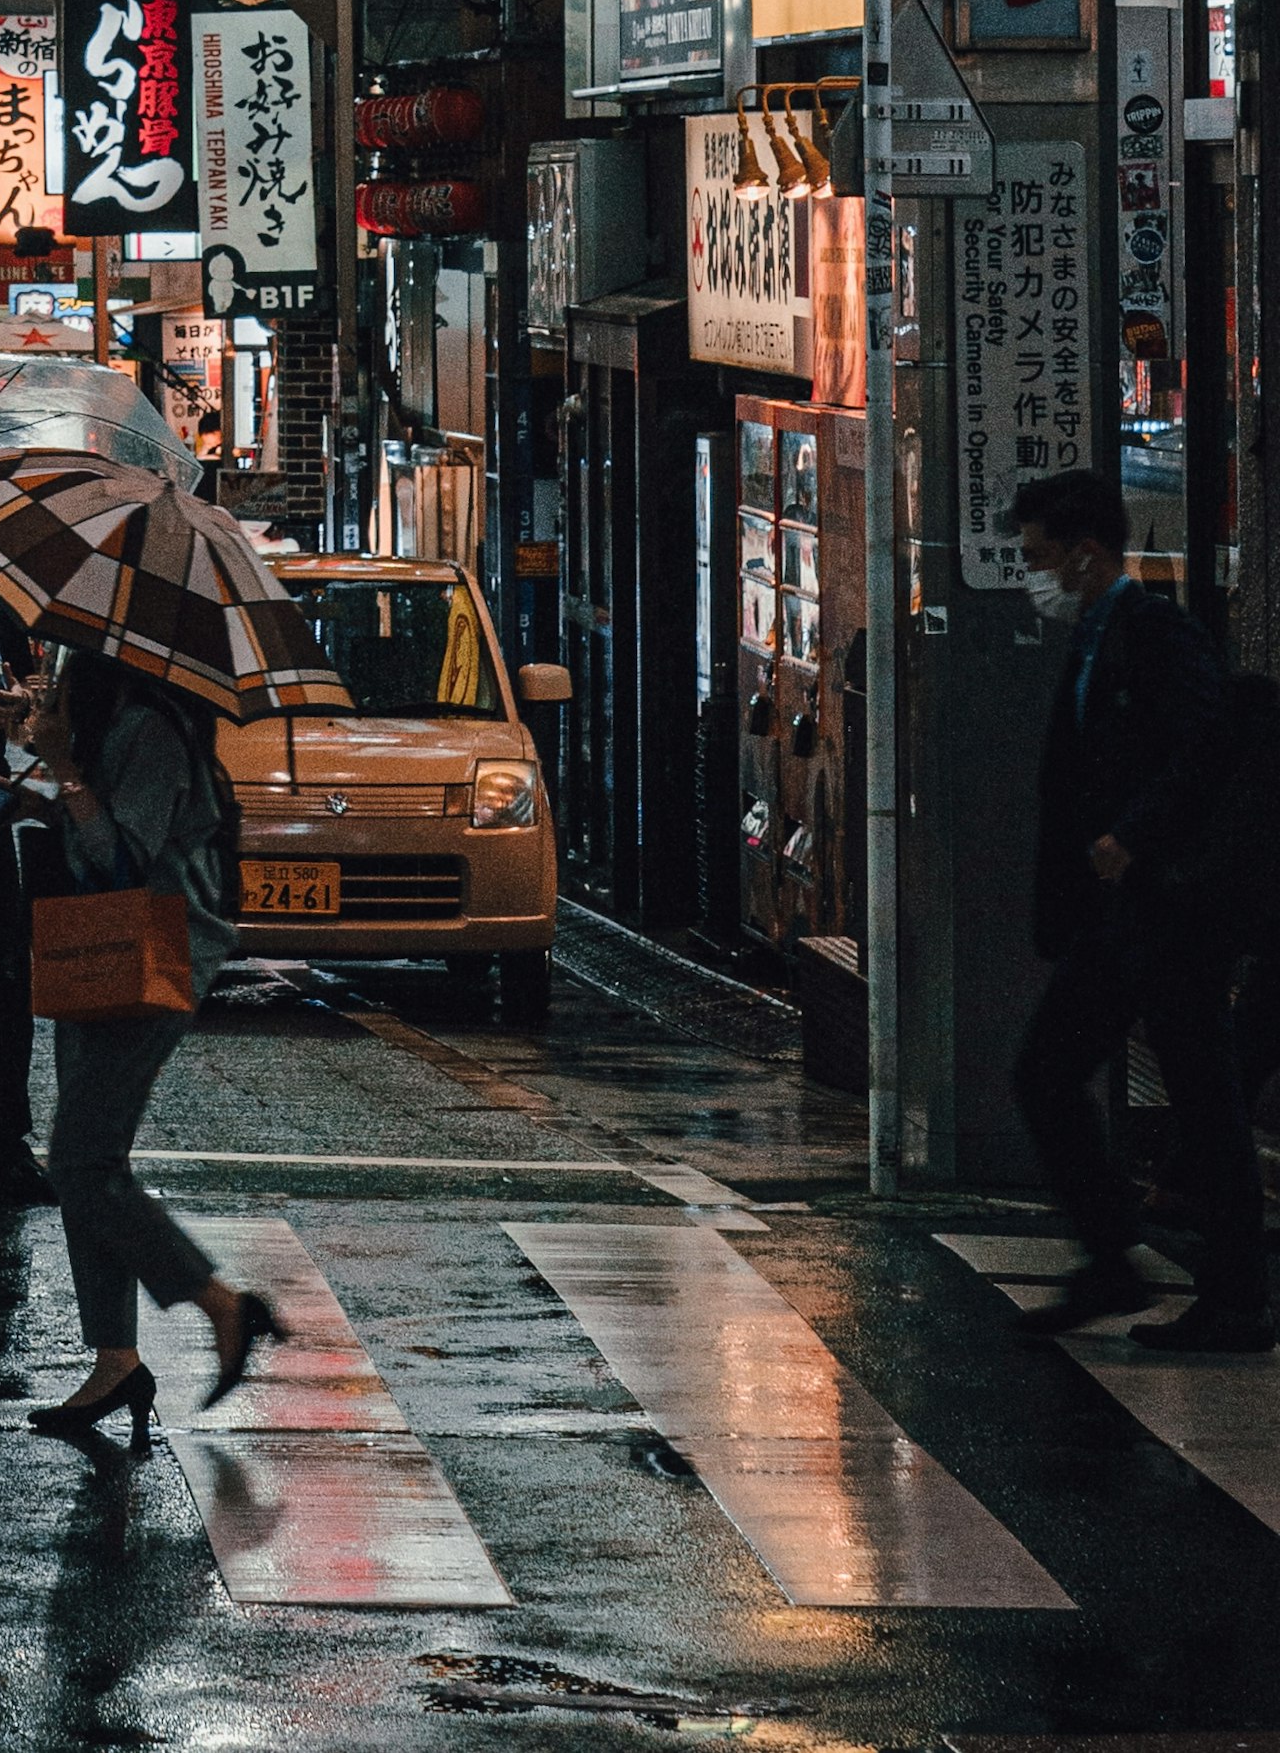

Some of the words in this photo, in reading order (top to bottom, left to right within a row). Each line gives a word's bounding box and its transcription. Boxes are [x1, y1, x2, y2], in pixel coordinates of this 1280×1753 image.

[202, 33, 223, 119] HIROSHIMA
[206, 128, 227, 190] TEPPAN
[235, 30, 308, 248] お好み焼き
[211, 190, 230, 232] YAKI
[986, 223, 1007, 273] Your
[259, 285, 315, 310] B1F
[964, 218, 985, 305] Security
[986, 280, 1008, 347] Safety
[1011, 180, 1049, 494] 防犯カメラ作動
[1048, 160, 1081, 468] みなさまの安全を守り
[966, 313, 986, 397] Camera
[968, 403, 985, 421] in
[967, 431, 988, 535] Operation
[260, 882, 331, 910] 24-61
